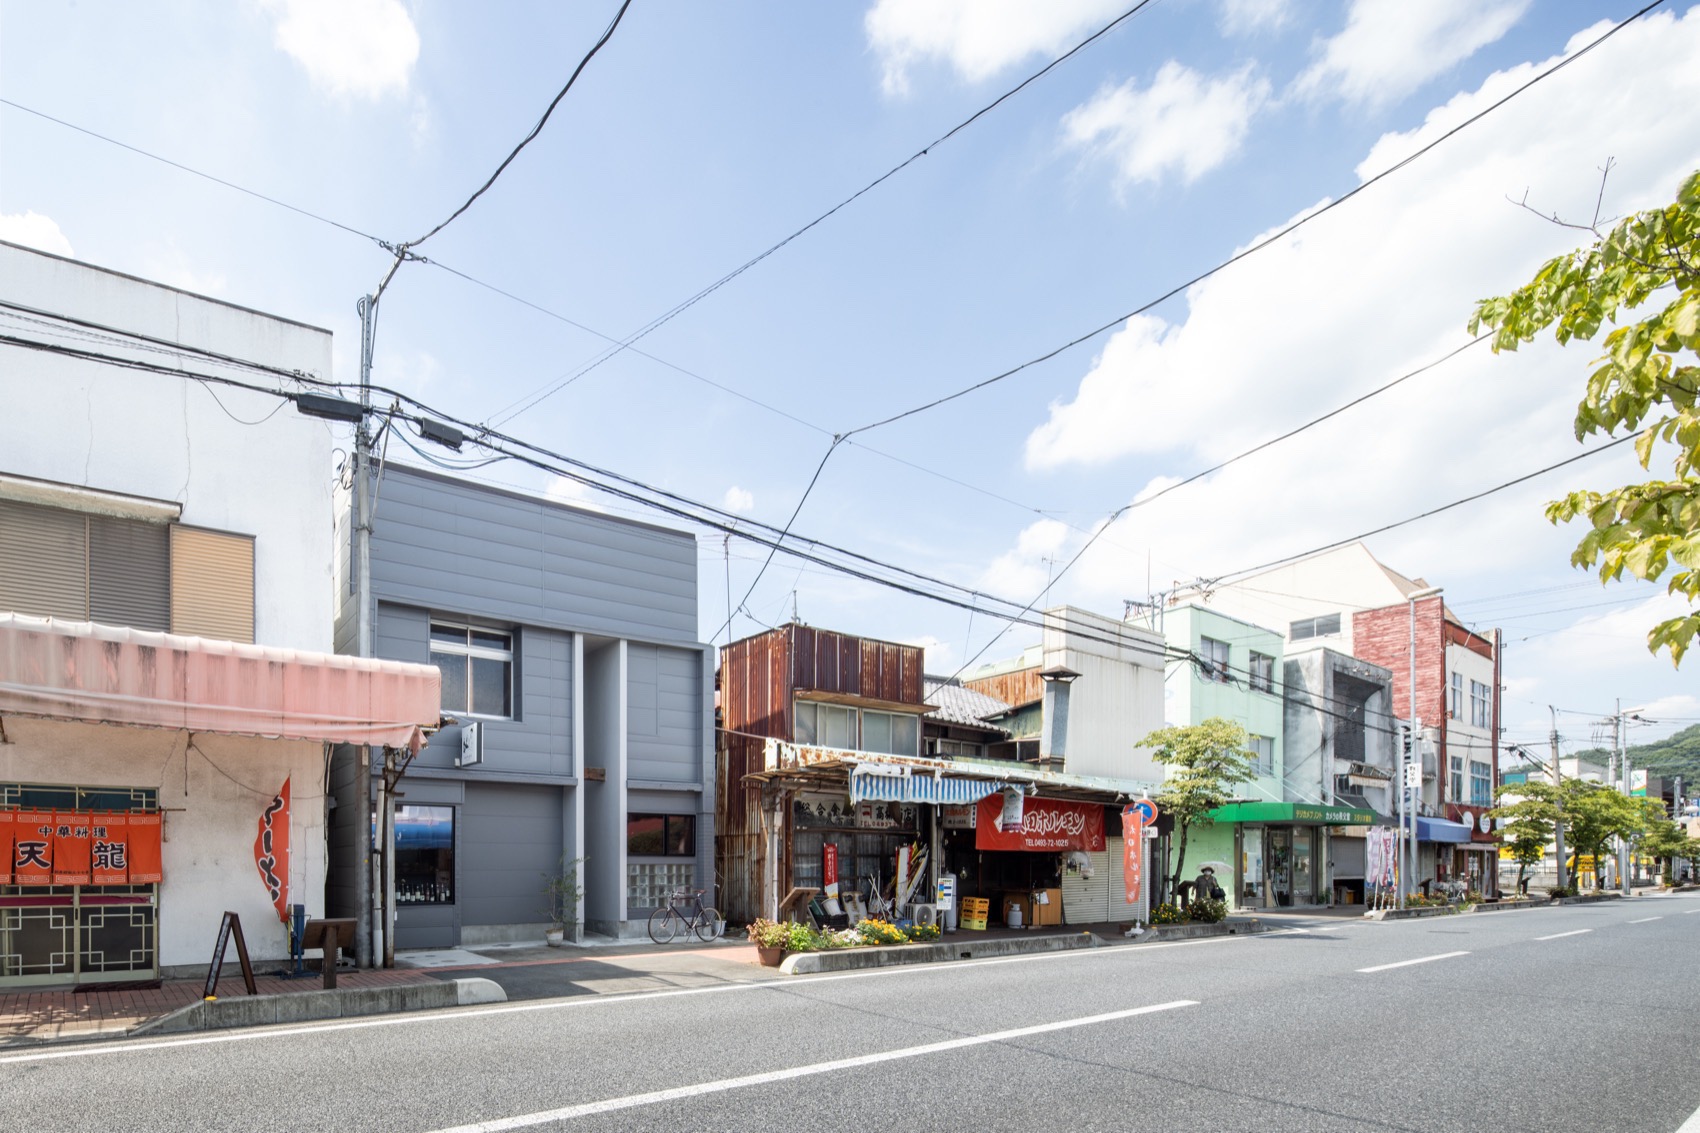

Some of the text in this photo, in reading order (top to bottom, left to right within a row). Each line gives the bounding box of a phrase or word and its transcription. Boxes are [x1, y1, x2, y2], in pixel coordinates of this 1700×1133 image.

[38, 825, 108, 838] 中華料理
[16, 841, 126, 870] 天龍
